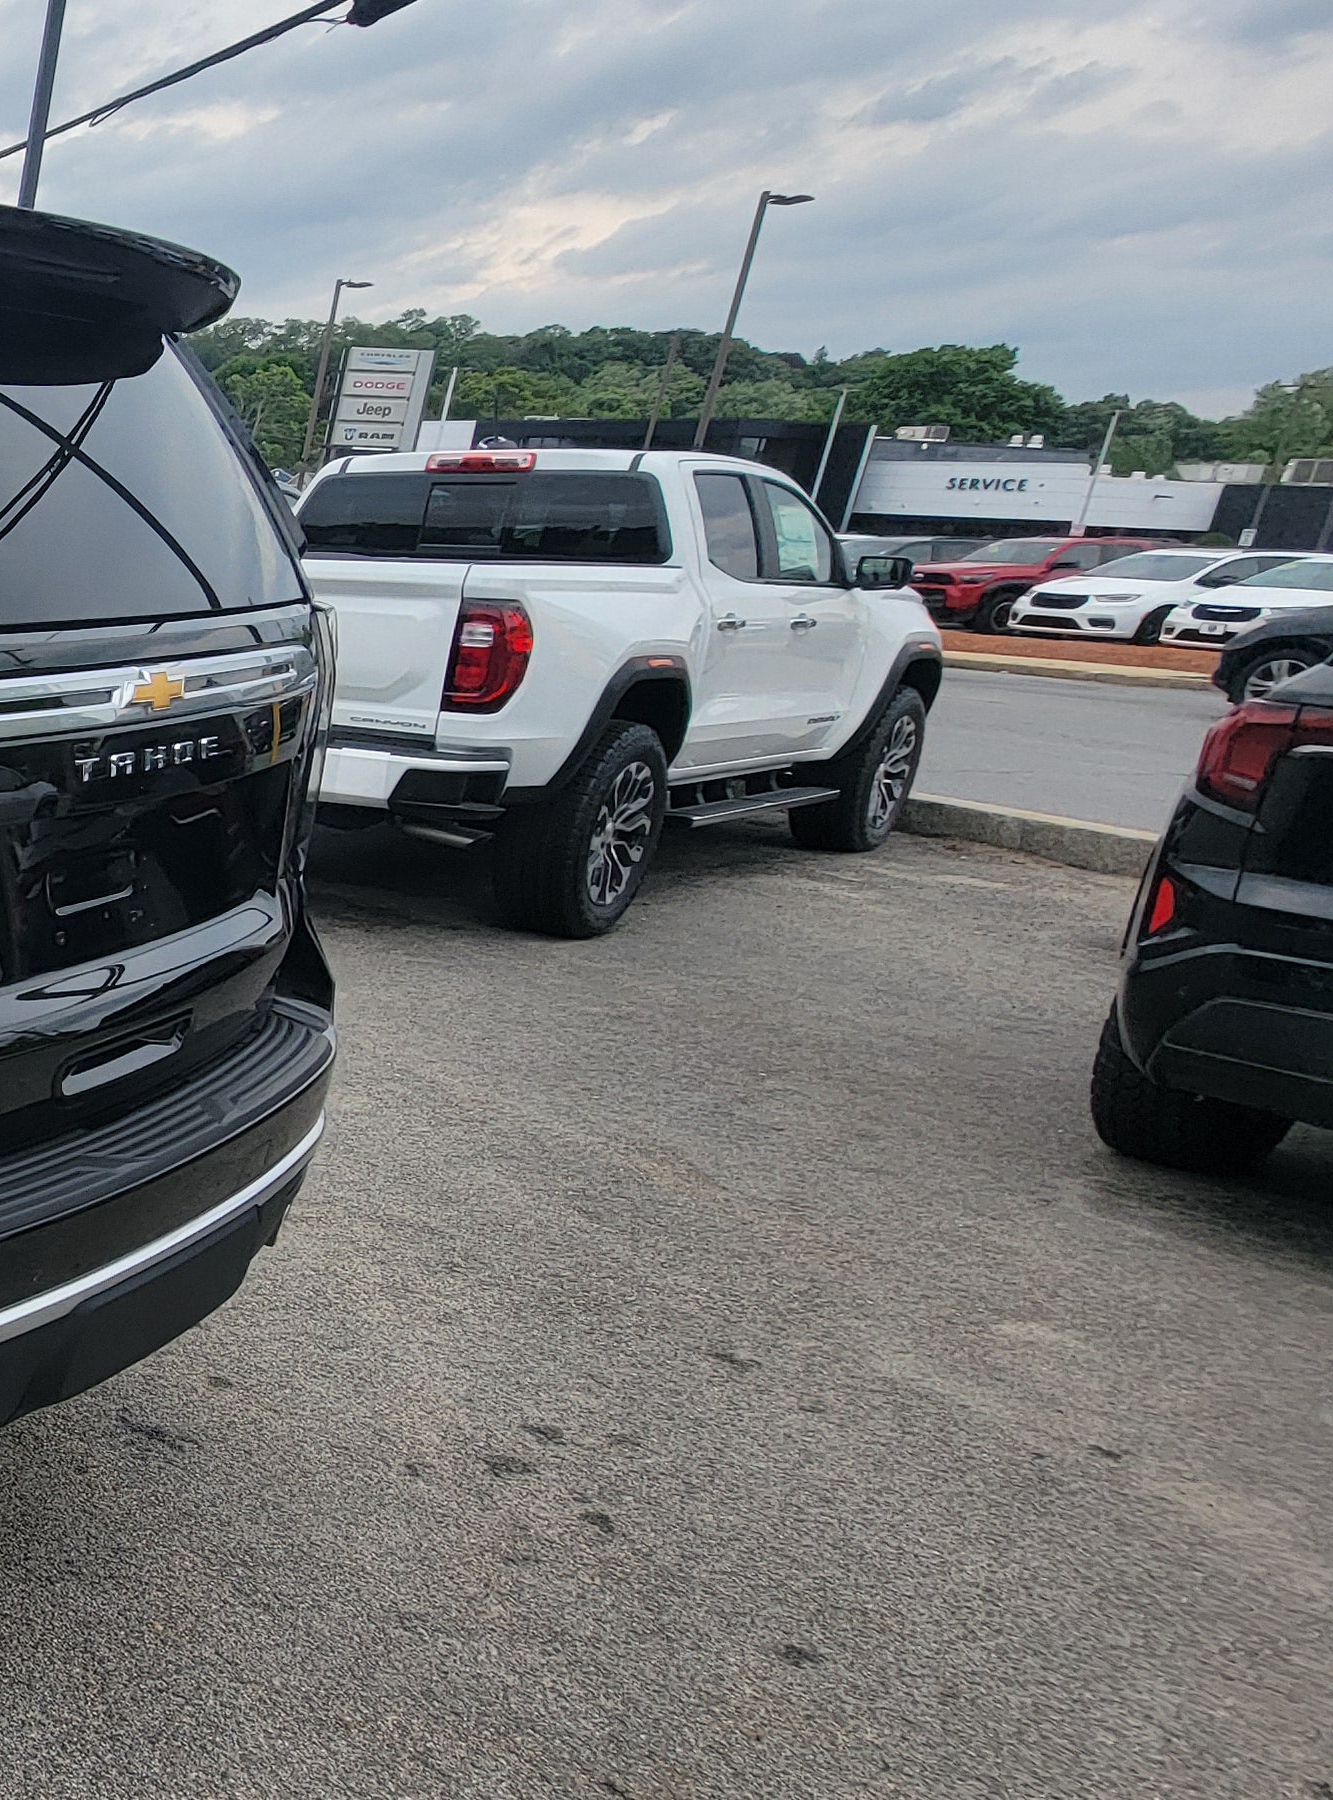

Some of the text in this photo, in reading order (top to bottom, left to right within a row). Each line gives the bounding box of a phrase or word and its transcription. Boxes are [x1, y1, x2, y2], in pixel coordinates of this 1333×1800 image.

[353, 381, 407, 390] DODGE
[356, 402, 392, 418] Jeep
[358, 431, 395, 440] RAM
[945, 477, 1029, 491] SERVICE
[349, 716, 427, 729] CANYON
[74, 735, 219, 783] TAHOE
